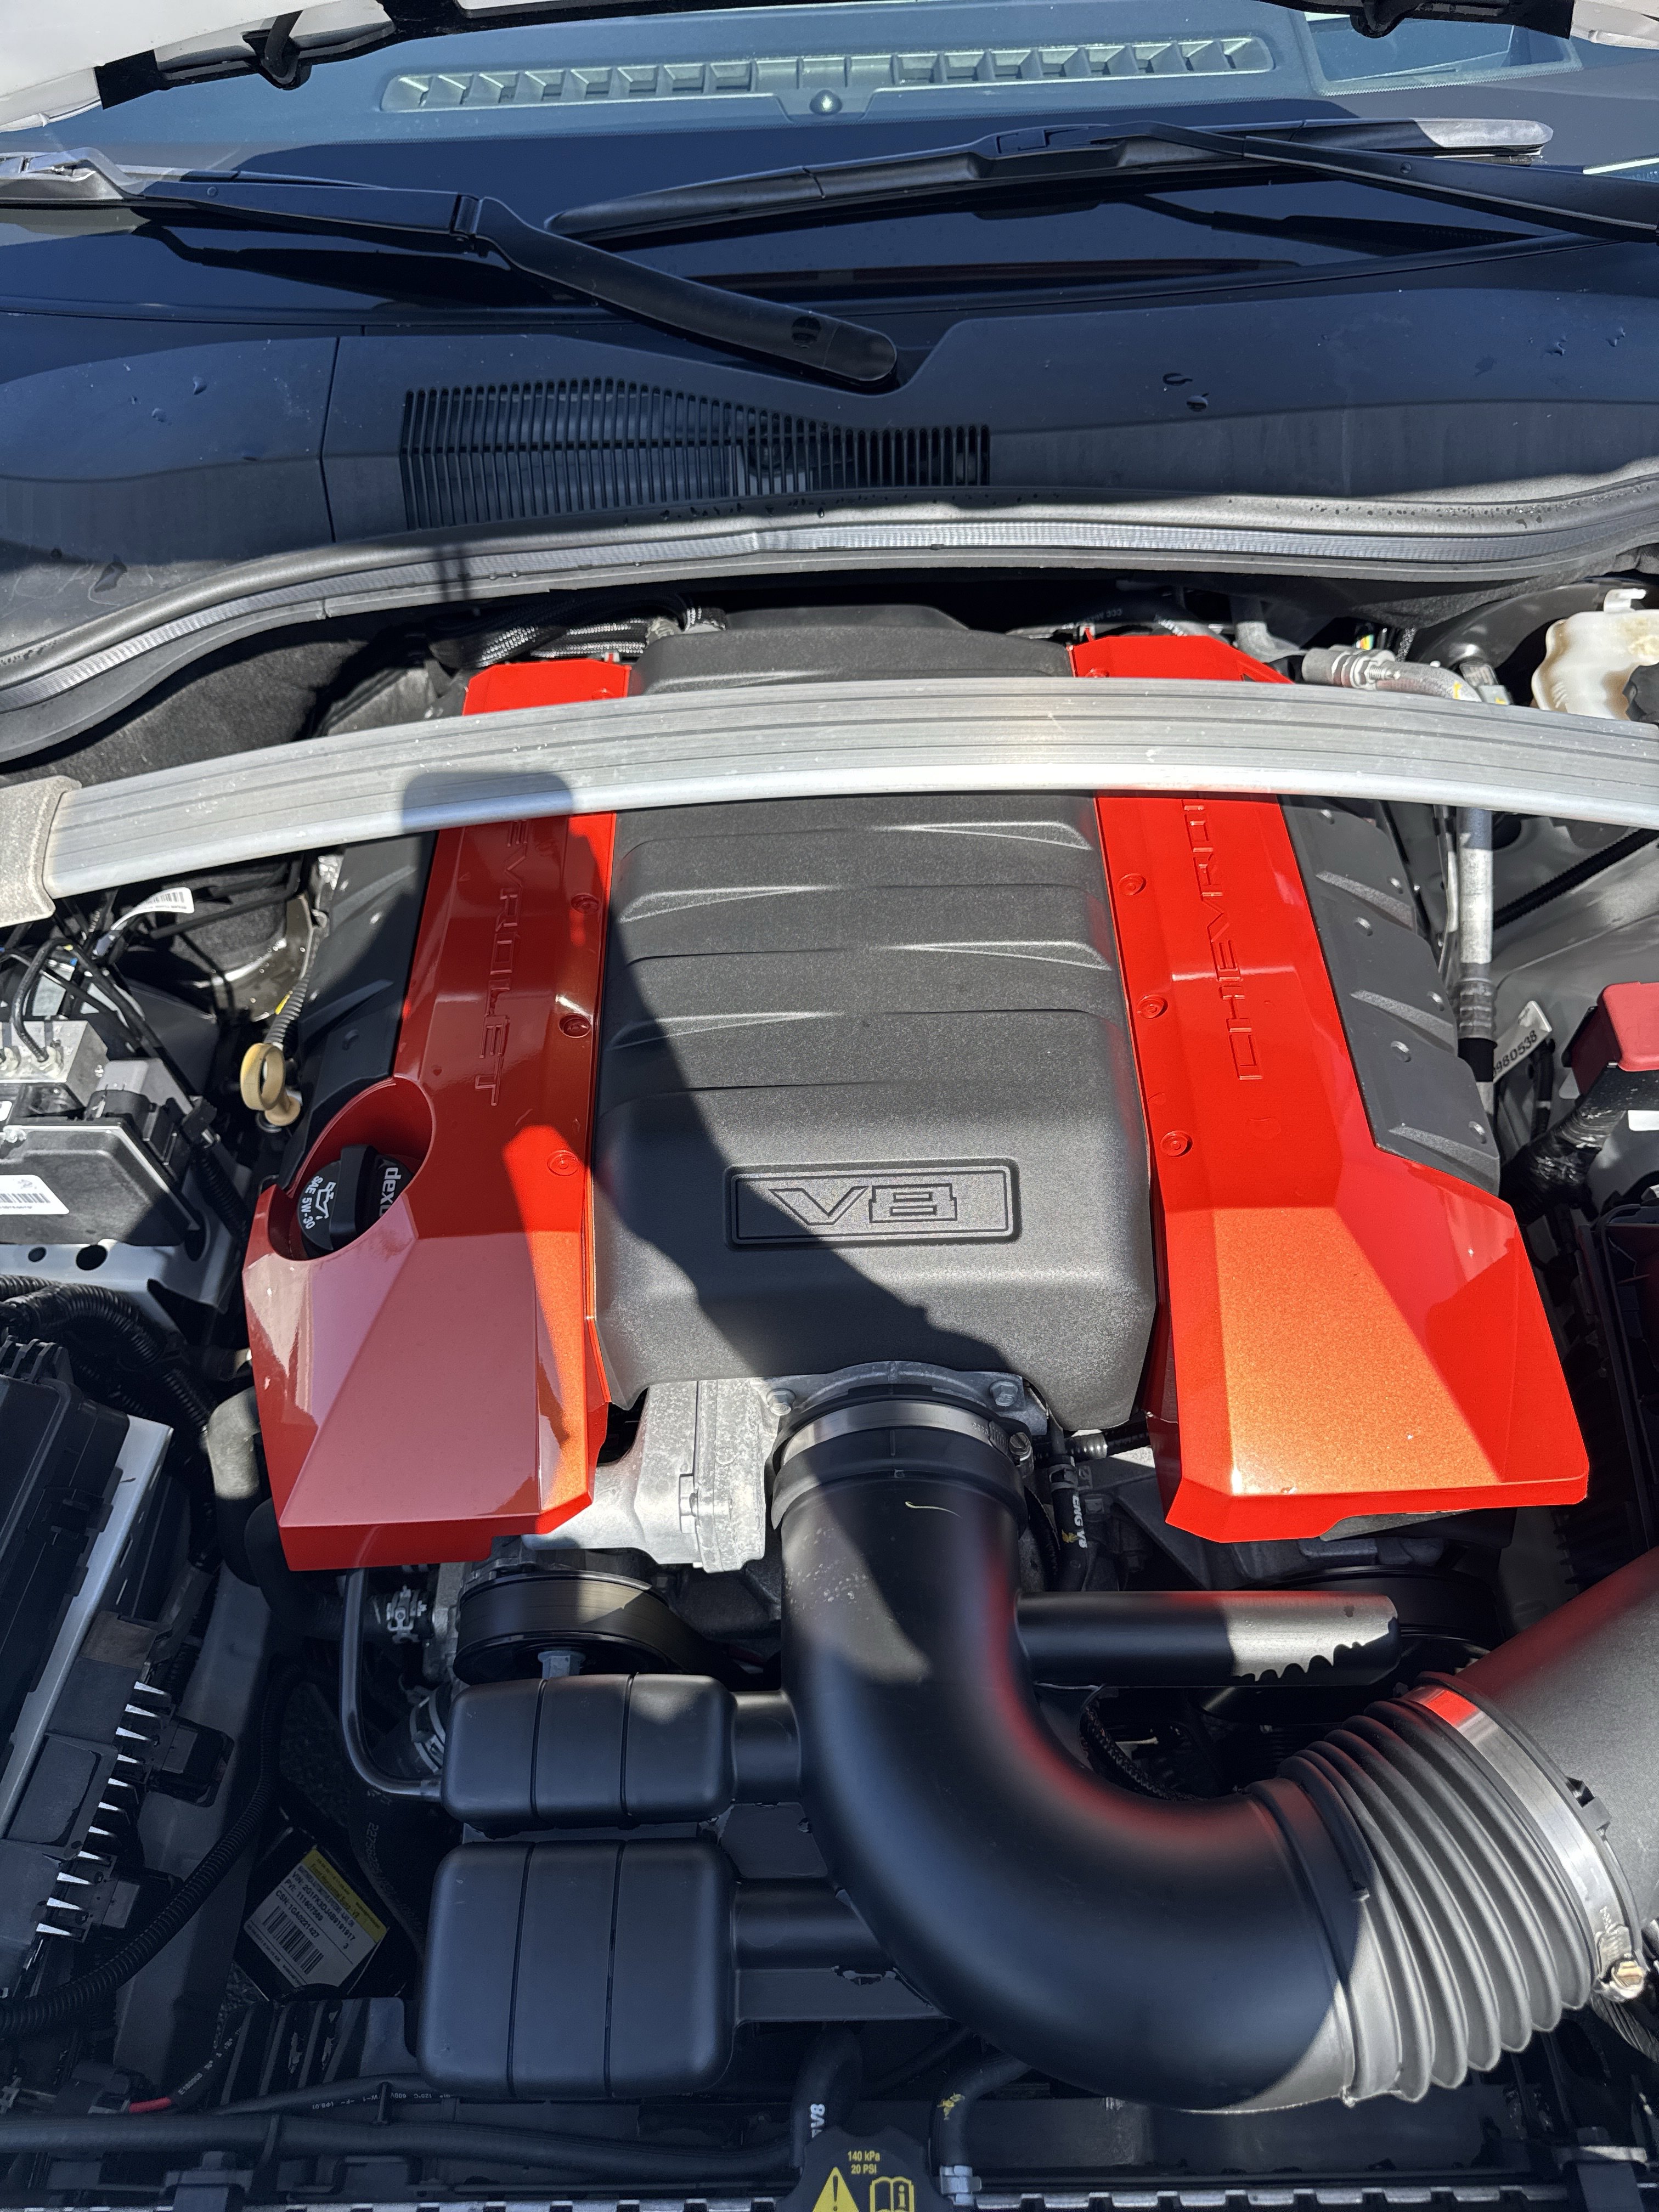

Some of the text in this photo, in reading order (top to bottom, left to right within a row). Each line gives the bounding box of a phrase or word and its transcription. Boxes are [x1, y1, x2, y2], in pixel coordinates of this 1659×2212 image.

[301, 1176, 323, 1229] SAE 5W-30
[768, 1183, 957, 1226] V8
[1072, 1495, 1084, 1527] ENG
[362, 2094, 380, 2102] W-1
[810, 2103, 825, 2128] V8
[848, 2150, 881, 2162] 140 kPa
[851, 2164, 877, 2175] 20 PSI
